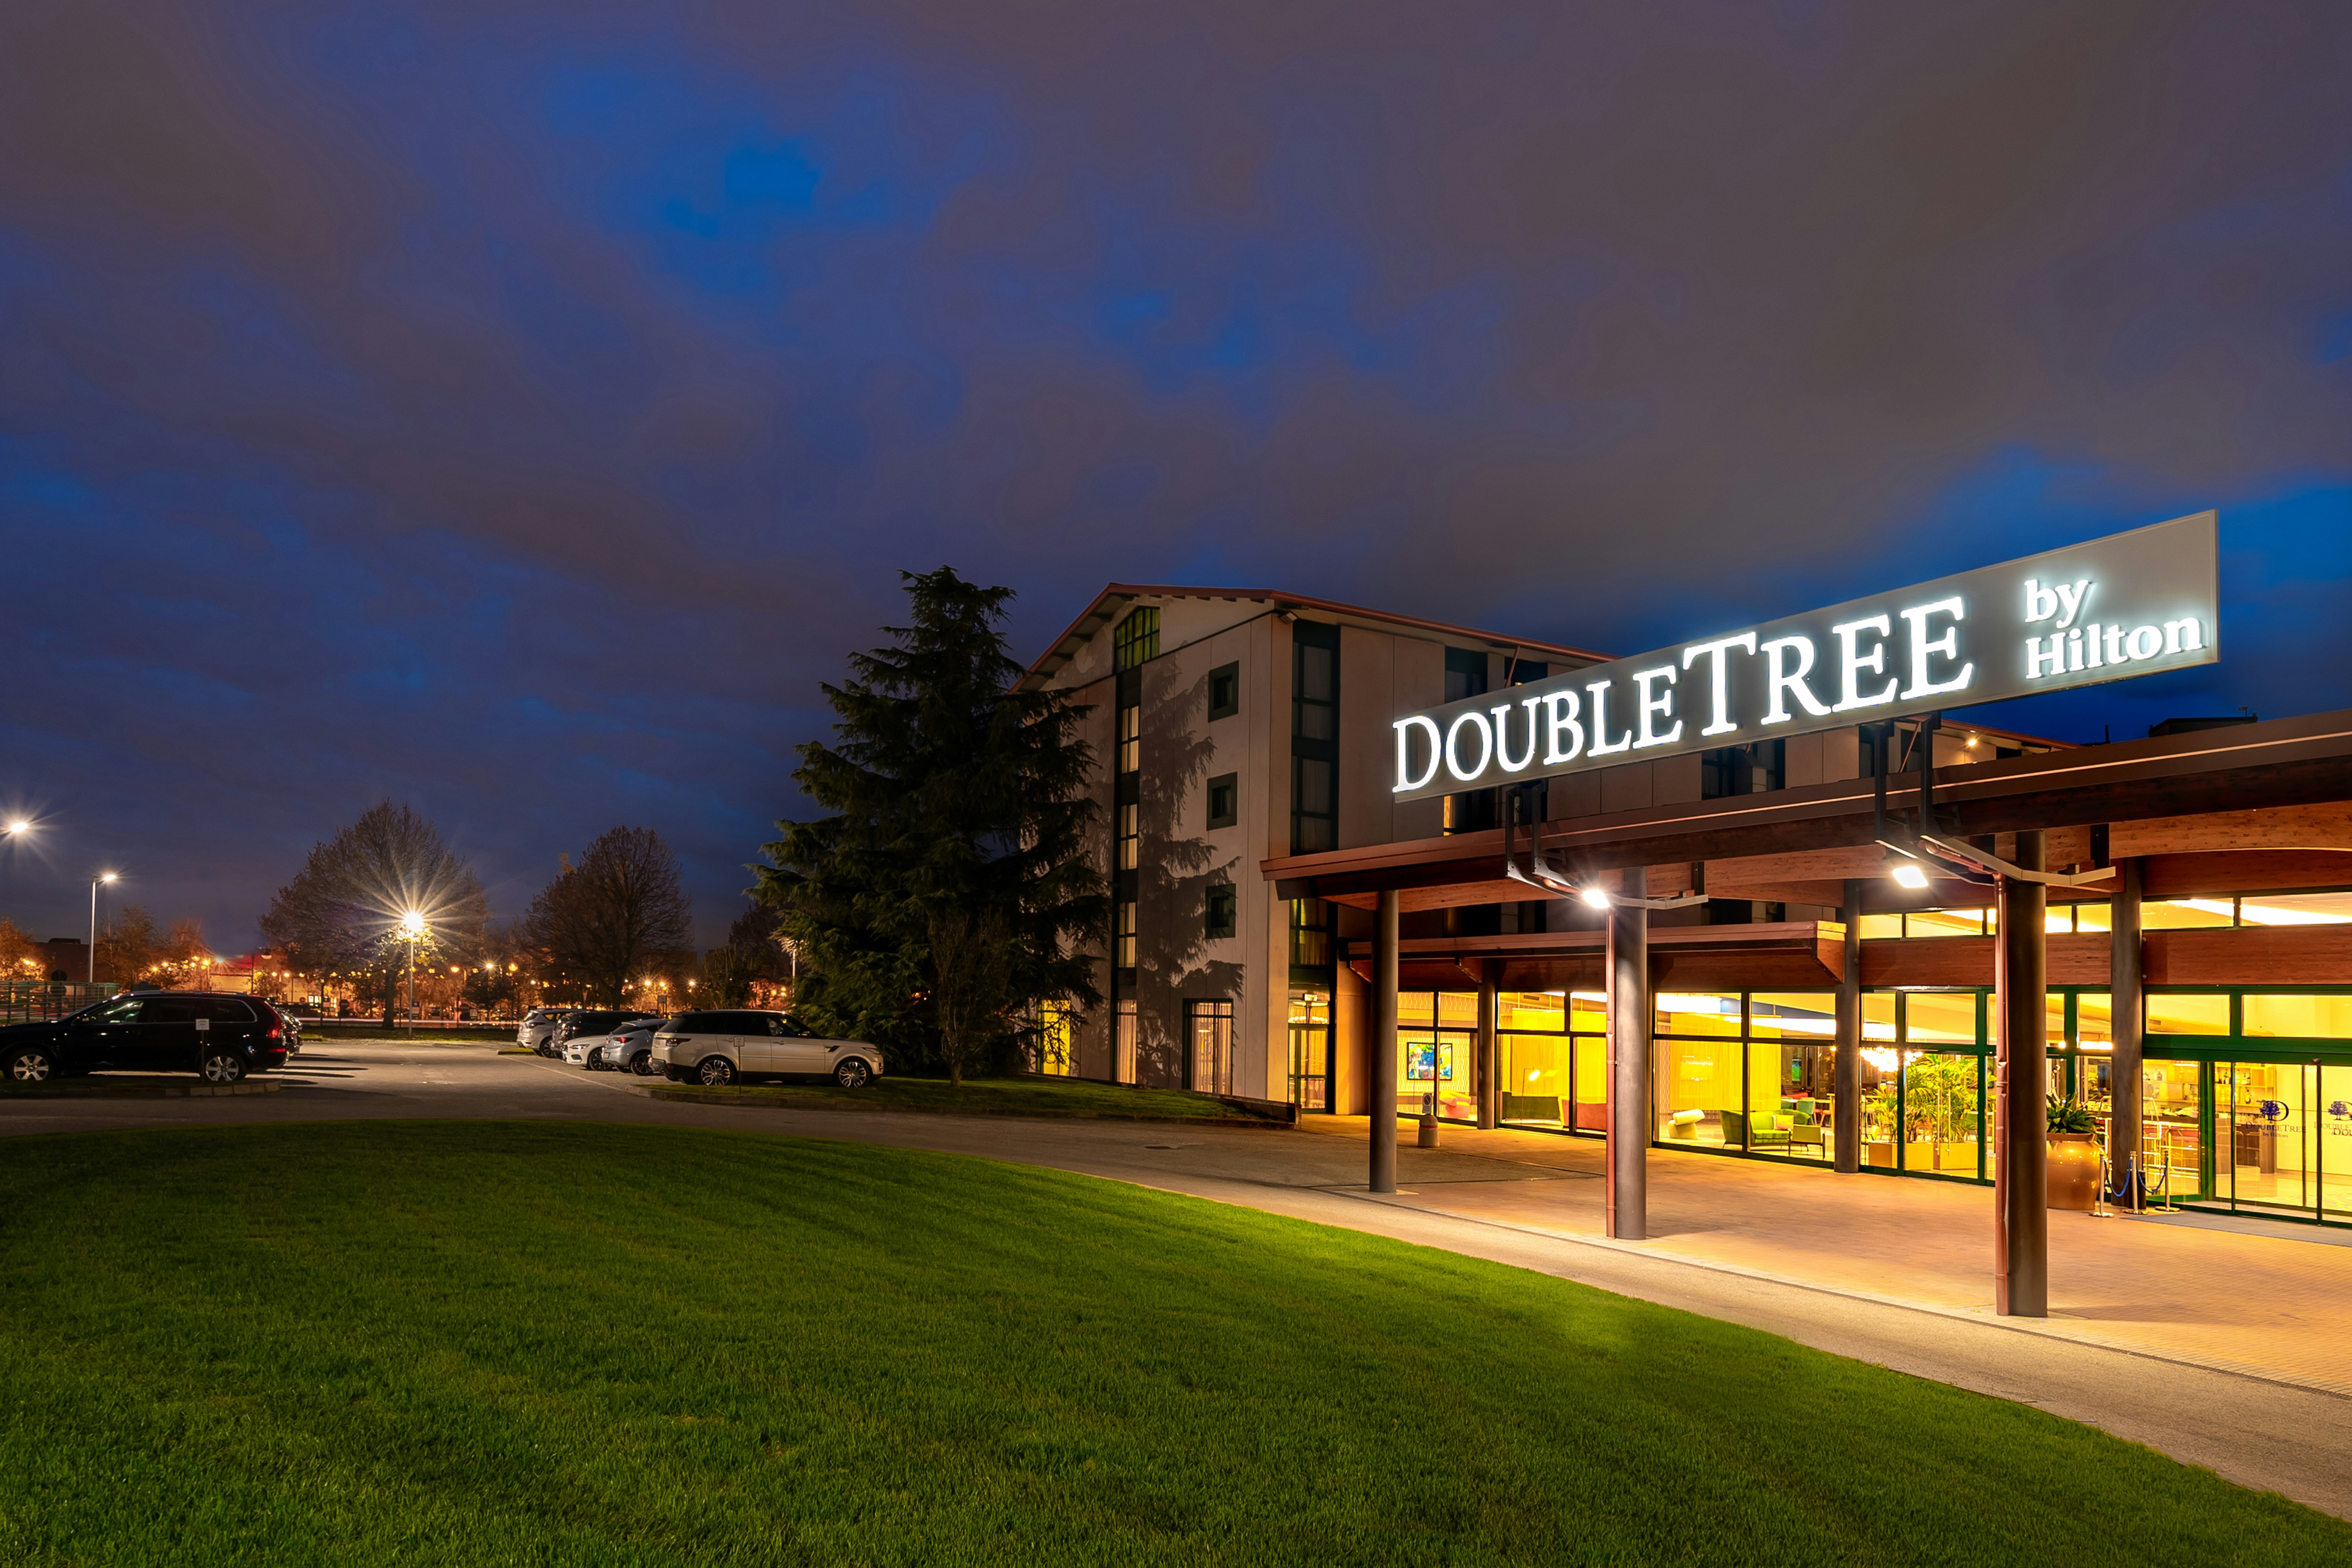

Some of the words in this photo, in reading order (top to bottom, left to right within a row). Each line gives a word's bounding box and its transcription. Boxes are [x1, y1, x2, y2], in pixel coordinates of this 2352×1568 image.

[2024, 579, 2089, 628] by
[2025, 617, 2203, 679] Hilton
[1392, 596, 1973, 793] DOUBLETREE
[2245, 1122, 2306, 1133] DOUBLETREE
